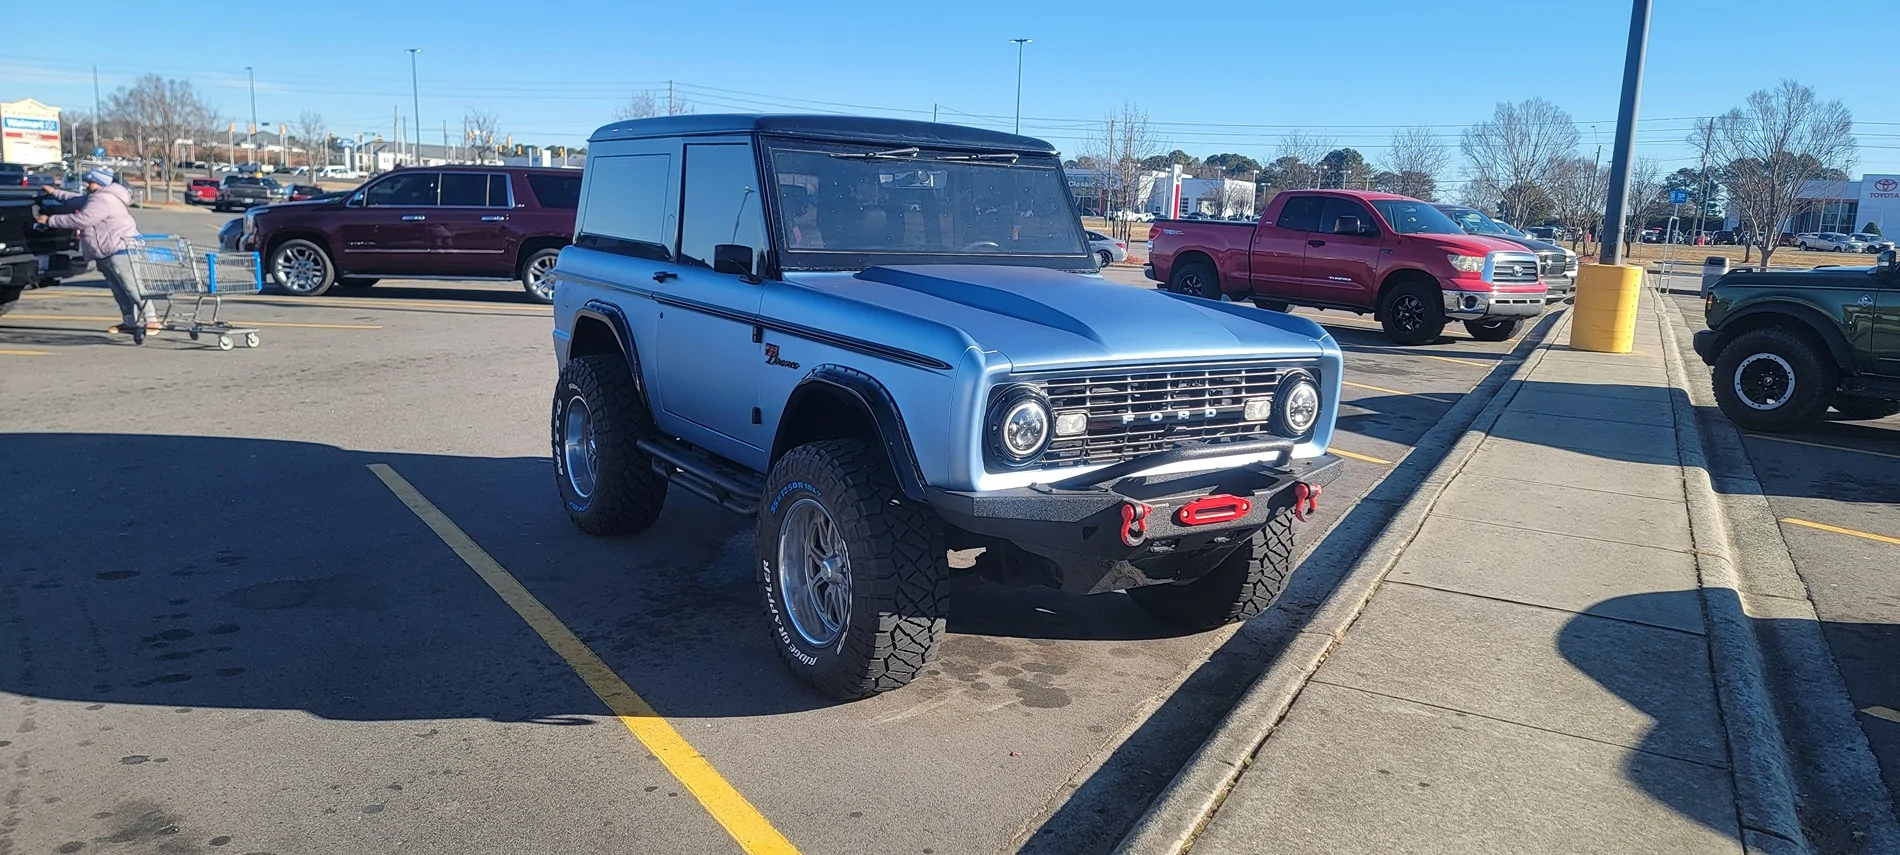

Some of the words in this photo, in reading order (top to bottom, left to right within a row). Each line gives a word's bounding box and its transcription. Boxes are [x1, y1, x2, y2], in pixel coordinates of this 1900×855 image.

[1122, 408, 1217, 425] FORD
[763, 559, 792, 645] GRAPPLER
[787, 643, 819, 666] RIDGE
